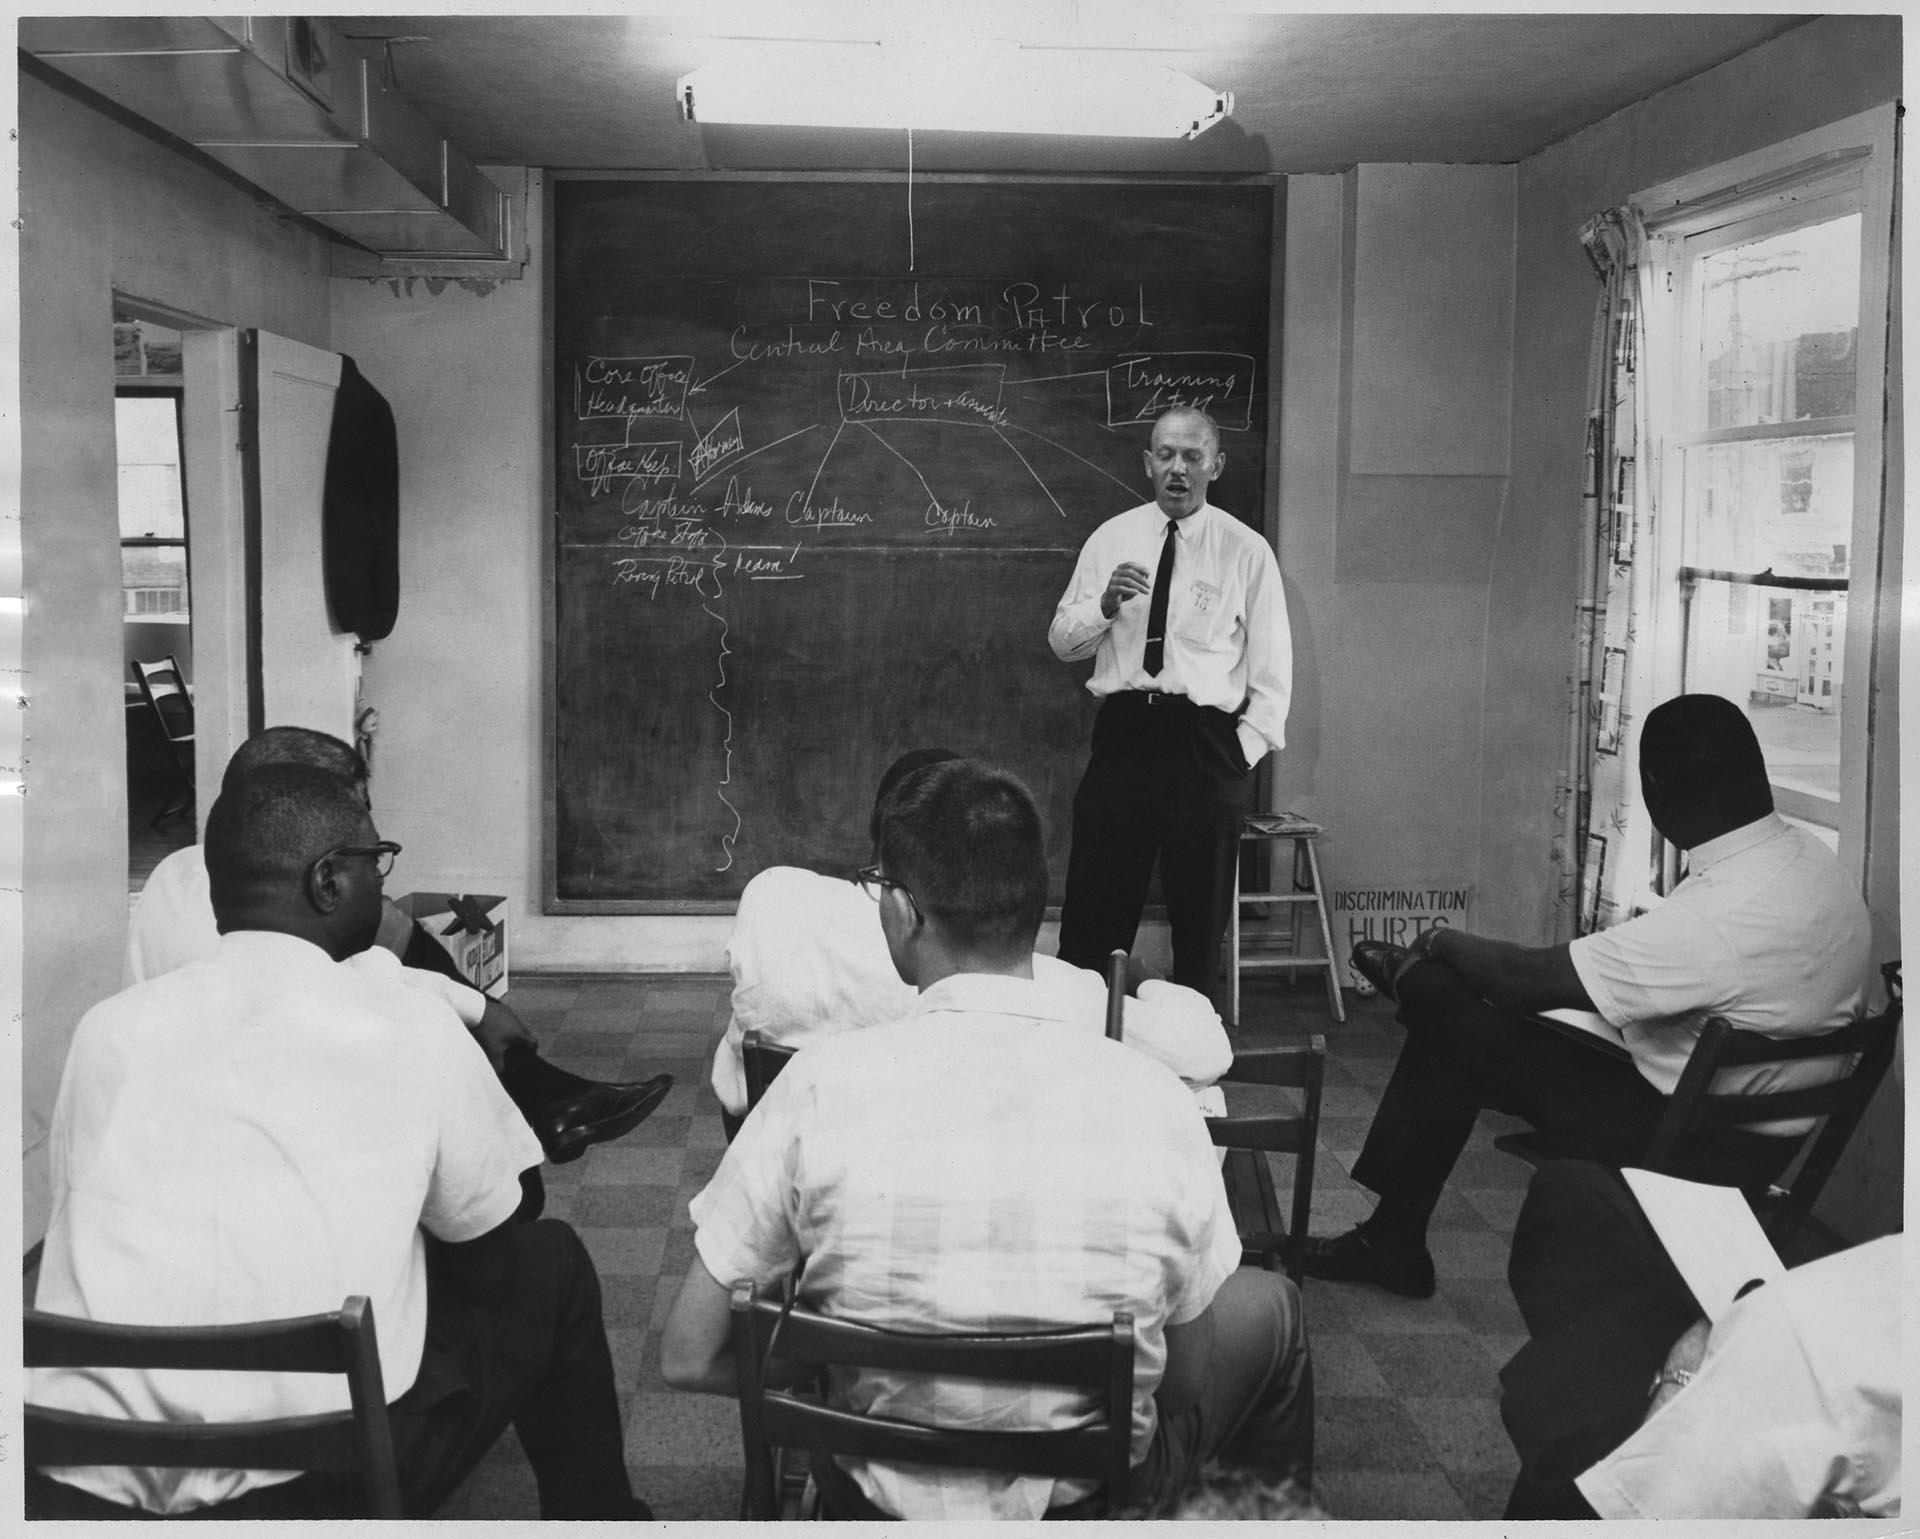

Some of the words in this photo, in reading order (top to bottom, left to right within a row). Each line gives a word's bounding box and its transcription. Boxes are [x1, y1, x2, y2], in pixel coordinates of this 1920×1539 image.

[808, 279, 982, 324] Freedom
[730, 324, 843, 361] Central
[855, 325, 911, 356] Area
[924, 323, 1091, 352] Committee
[586, 360, 632, 385] Core
[640, 361, 688, 398] Office
[846, 373, 941, 414] Director
[1112, 357, 1236, 399] Training
[621, 475, 709, 528] Captain
[785, 490, 874, 534] Captain
[925, 500, 999, 536] Captain
[1334, 890, 1467, 911] DISCRIMINATION
